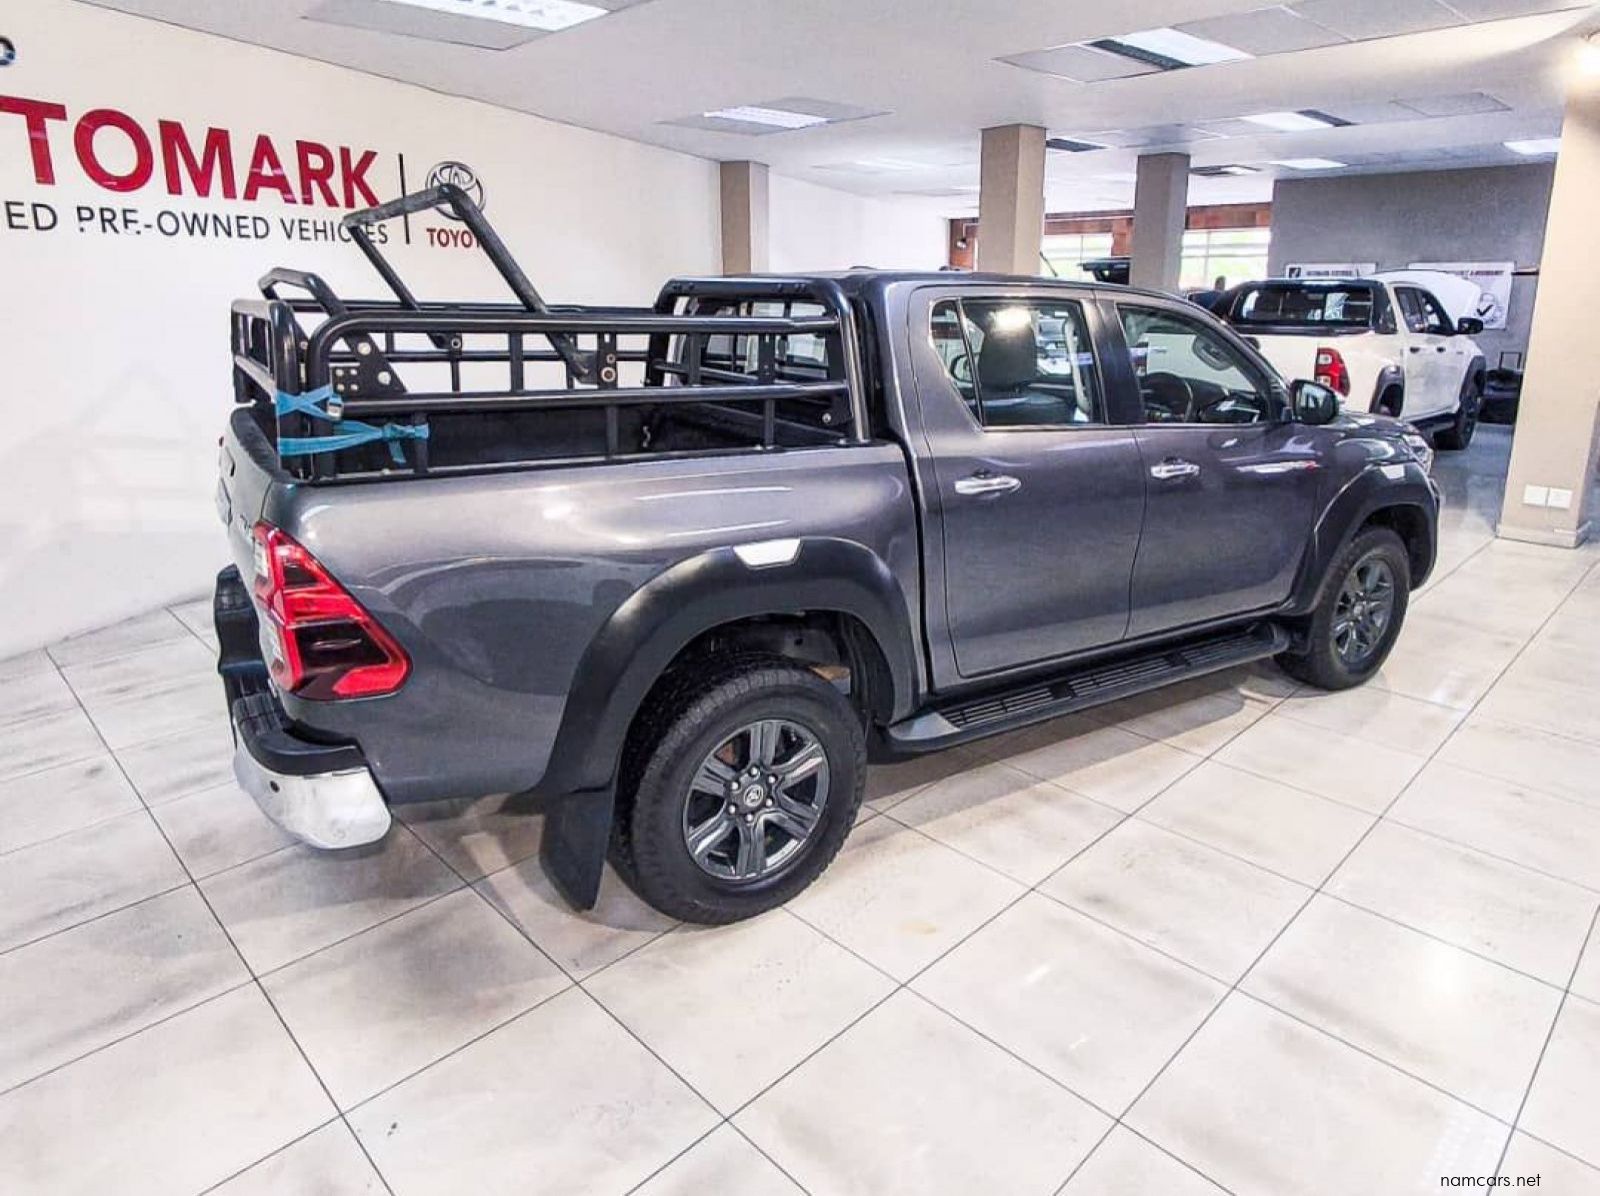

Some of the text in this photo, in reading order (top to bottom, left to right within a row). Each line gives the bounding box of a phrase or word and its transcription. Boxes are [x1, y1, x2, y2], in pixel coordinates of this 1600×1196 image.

[4, 200, 389, 244] ED PRE-OWNED VEHICES
